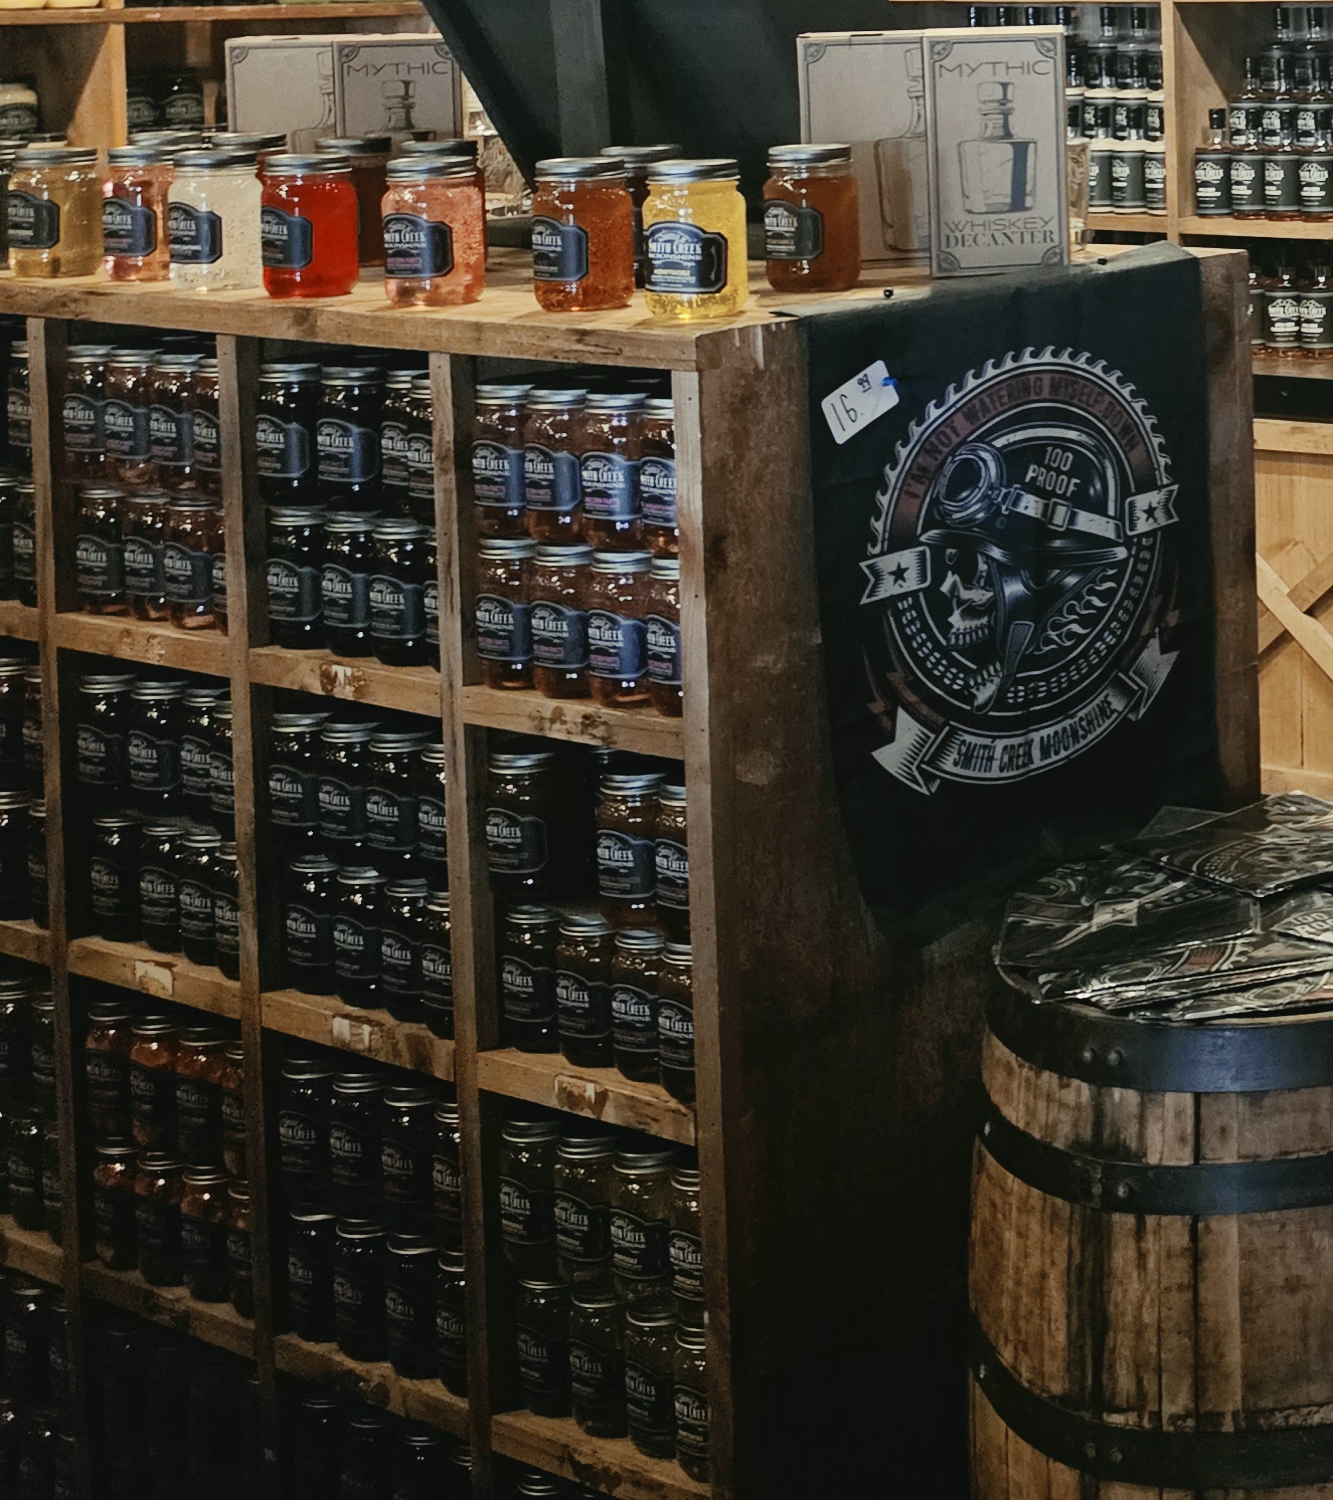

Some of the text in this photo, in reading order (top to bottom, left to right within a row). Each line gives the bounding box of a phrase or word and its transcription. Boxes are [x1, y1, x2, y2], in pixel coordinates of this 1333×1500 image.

[347, 60, 448, 77] MYTHIC
[938, 60, 1052, 77] MYTHIC
[945, 216, 1055, 234] WHISKEY
[945, 230, 1055, 248] DECANTER
[925, 418, 961, 462] NOT
[963, 376, 1044, 423] WATERING
[1100, 396, 1142, 448] DOWN
[1043, 446, 1074, 472] 100
[1025, 463, 1081, 497] PROOF
[953, 693, 1117, 774] SMITH CREEK MOONSHINE
[1290, 912, 1329, 925] 100
